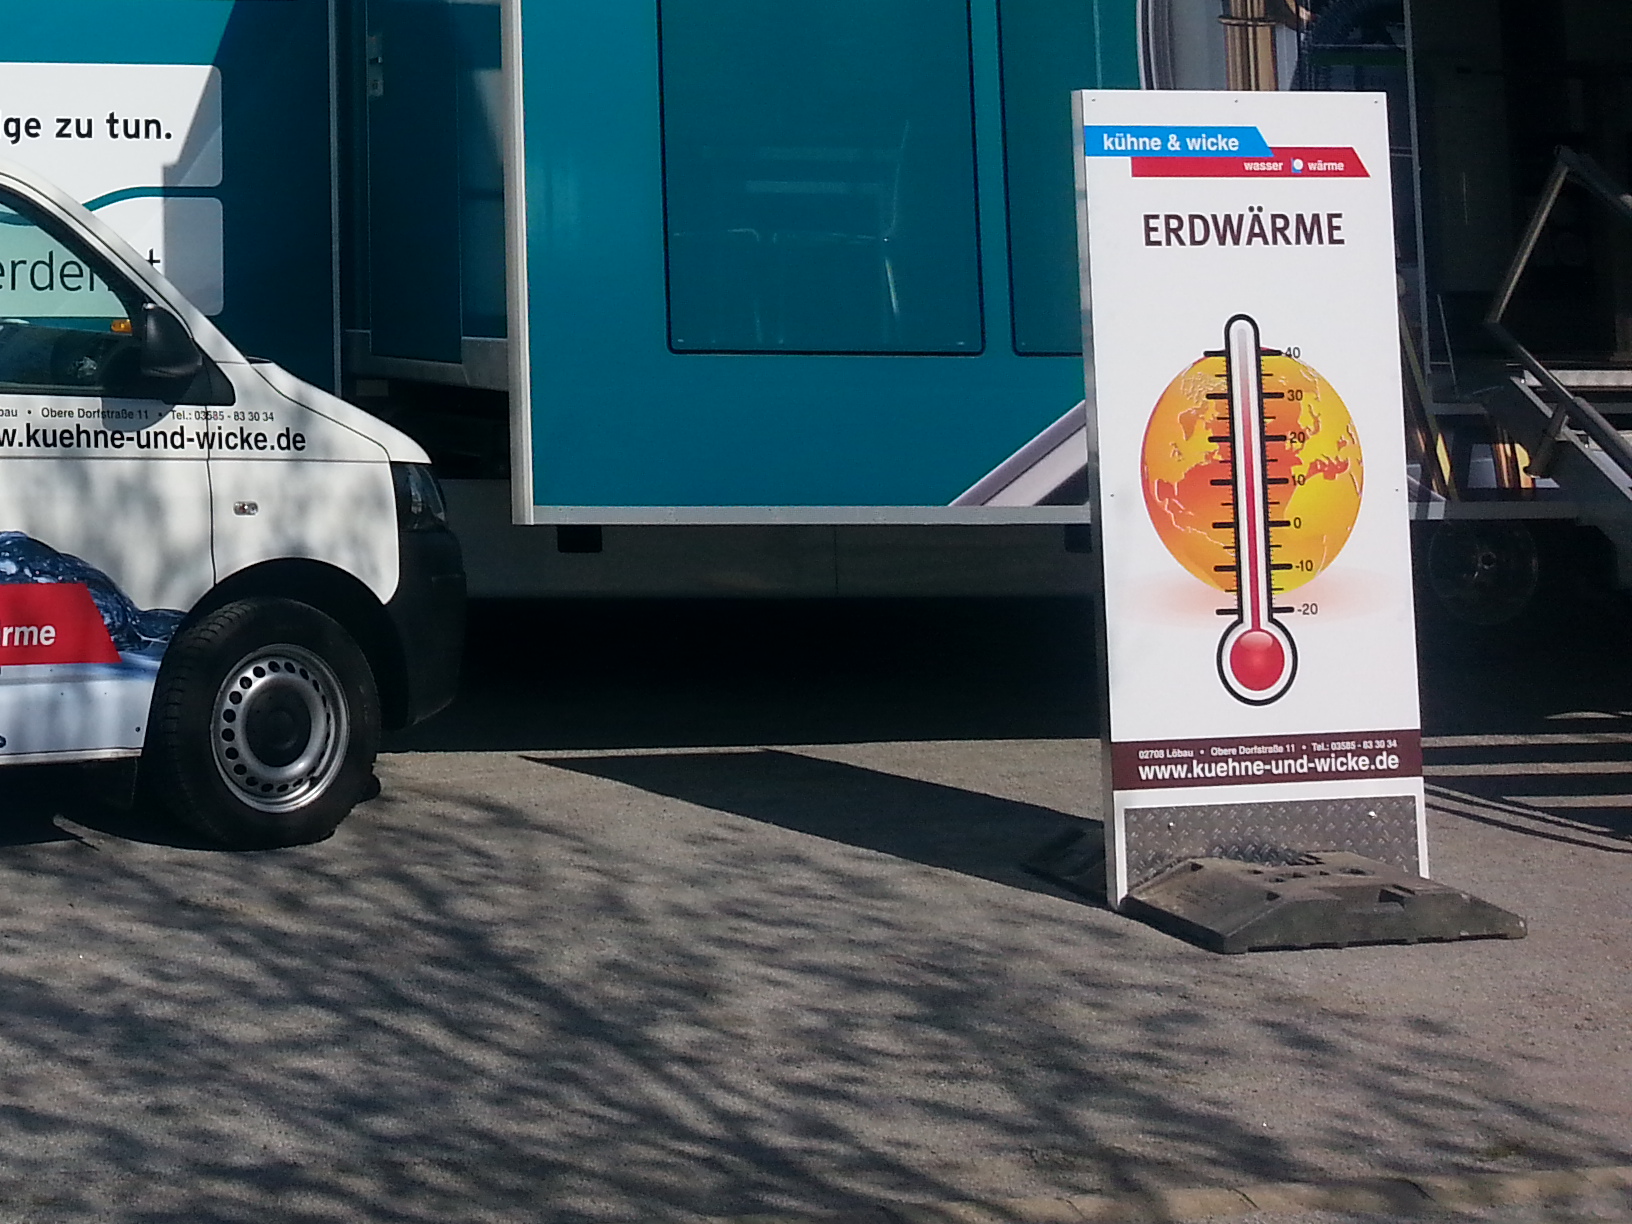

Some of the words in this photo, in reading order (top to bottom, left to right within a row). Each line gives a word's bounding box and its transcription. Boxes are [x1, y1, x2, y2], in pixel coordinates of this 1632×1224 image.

[56, 118, 93, 139] zu
[106, 112, 172, 140] tun.
[1103, 133, 1161, 151] kühne
[1167, 134, 1181, 151] &
[1186, 133, 1239, 151] wicke
[1244, 161, 1283, 171] wasser
[1308, 159, 1344, 171] wärme
[1143, 205, 1345, 246] ERDWÄRME
[1285, 346, 1301, 359] 40
[1287, 389, 1303, 402] 30
[41, 407, 74, 419] Obere
[77, 407, 133, 420] Dorfstraße
[137, 409, 148, 419] 11
[171, 410, 192, 421] Tel.:
[194, 411, 225, 421] 03585
[234, 411, 246, 422] 83
[248, 412, 260, 422] 30
[262, 412, 274, 422] 34
[1289, 432, 1305, 444] 20
[1291, 475, 1305, 487] 10
[1293, 517, 1302, 529] 0
[1295, 560, 1313, 572] -10
[1297, 603, 1319, 616] -20
[1286, 744, 1295, 752] 11
[1375, 740, 1385, 748] 30
[1138, 751, 1399, 780] www.kuehne-und-wicke.de
